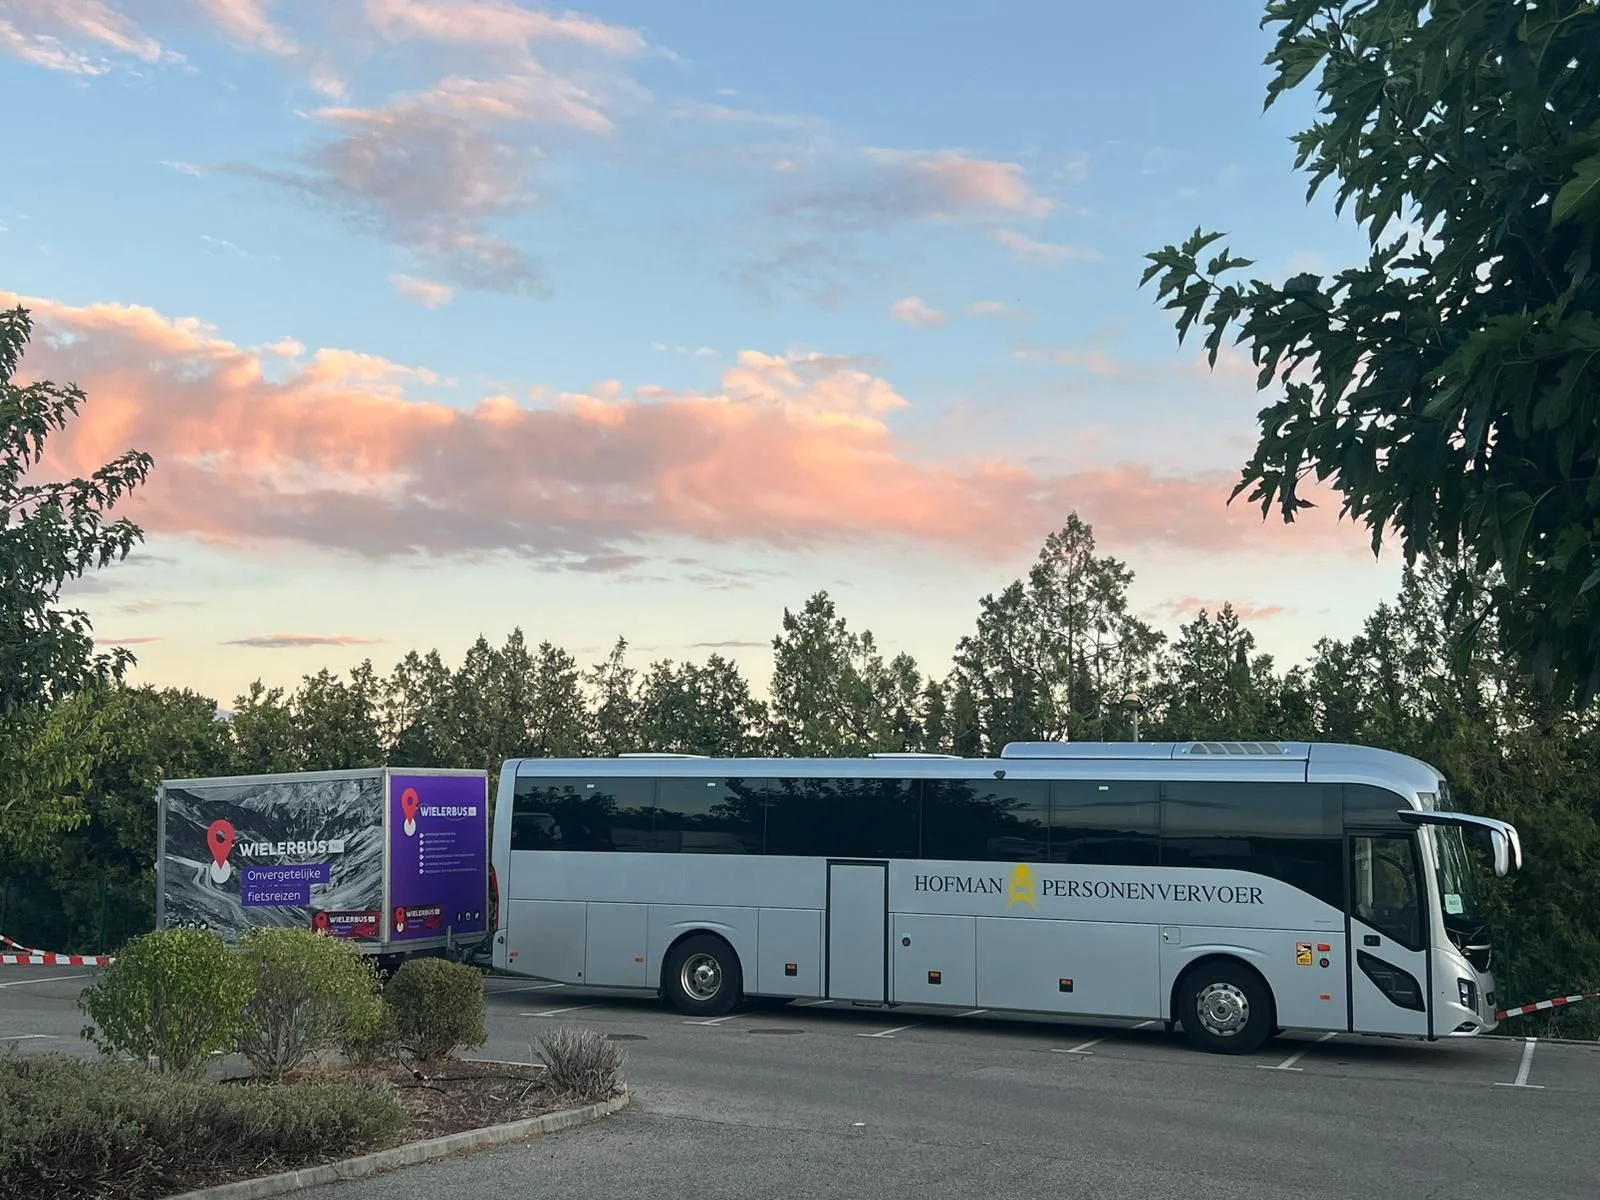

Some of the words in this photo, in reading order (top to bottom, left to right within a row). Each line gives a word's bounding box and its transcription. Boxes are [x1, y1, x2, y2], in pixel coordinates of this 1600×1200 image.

[420, 806, 468, 817] WIELERBUS
[239, 840, 328, 857] WIELERBUS
[247, 869, 321, 883] Onvergetelijke
[247, 890, 301, 903] fietsreizen
[914, 875, 1003, 894] HOFMAN
[1042, 879, 1265, 905] PERSONENVERVOER
[329, 915, 368, 923] WIELERBUS
[406, 908, 434, 918] WIELERBUS
